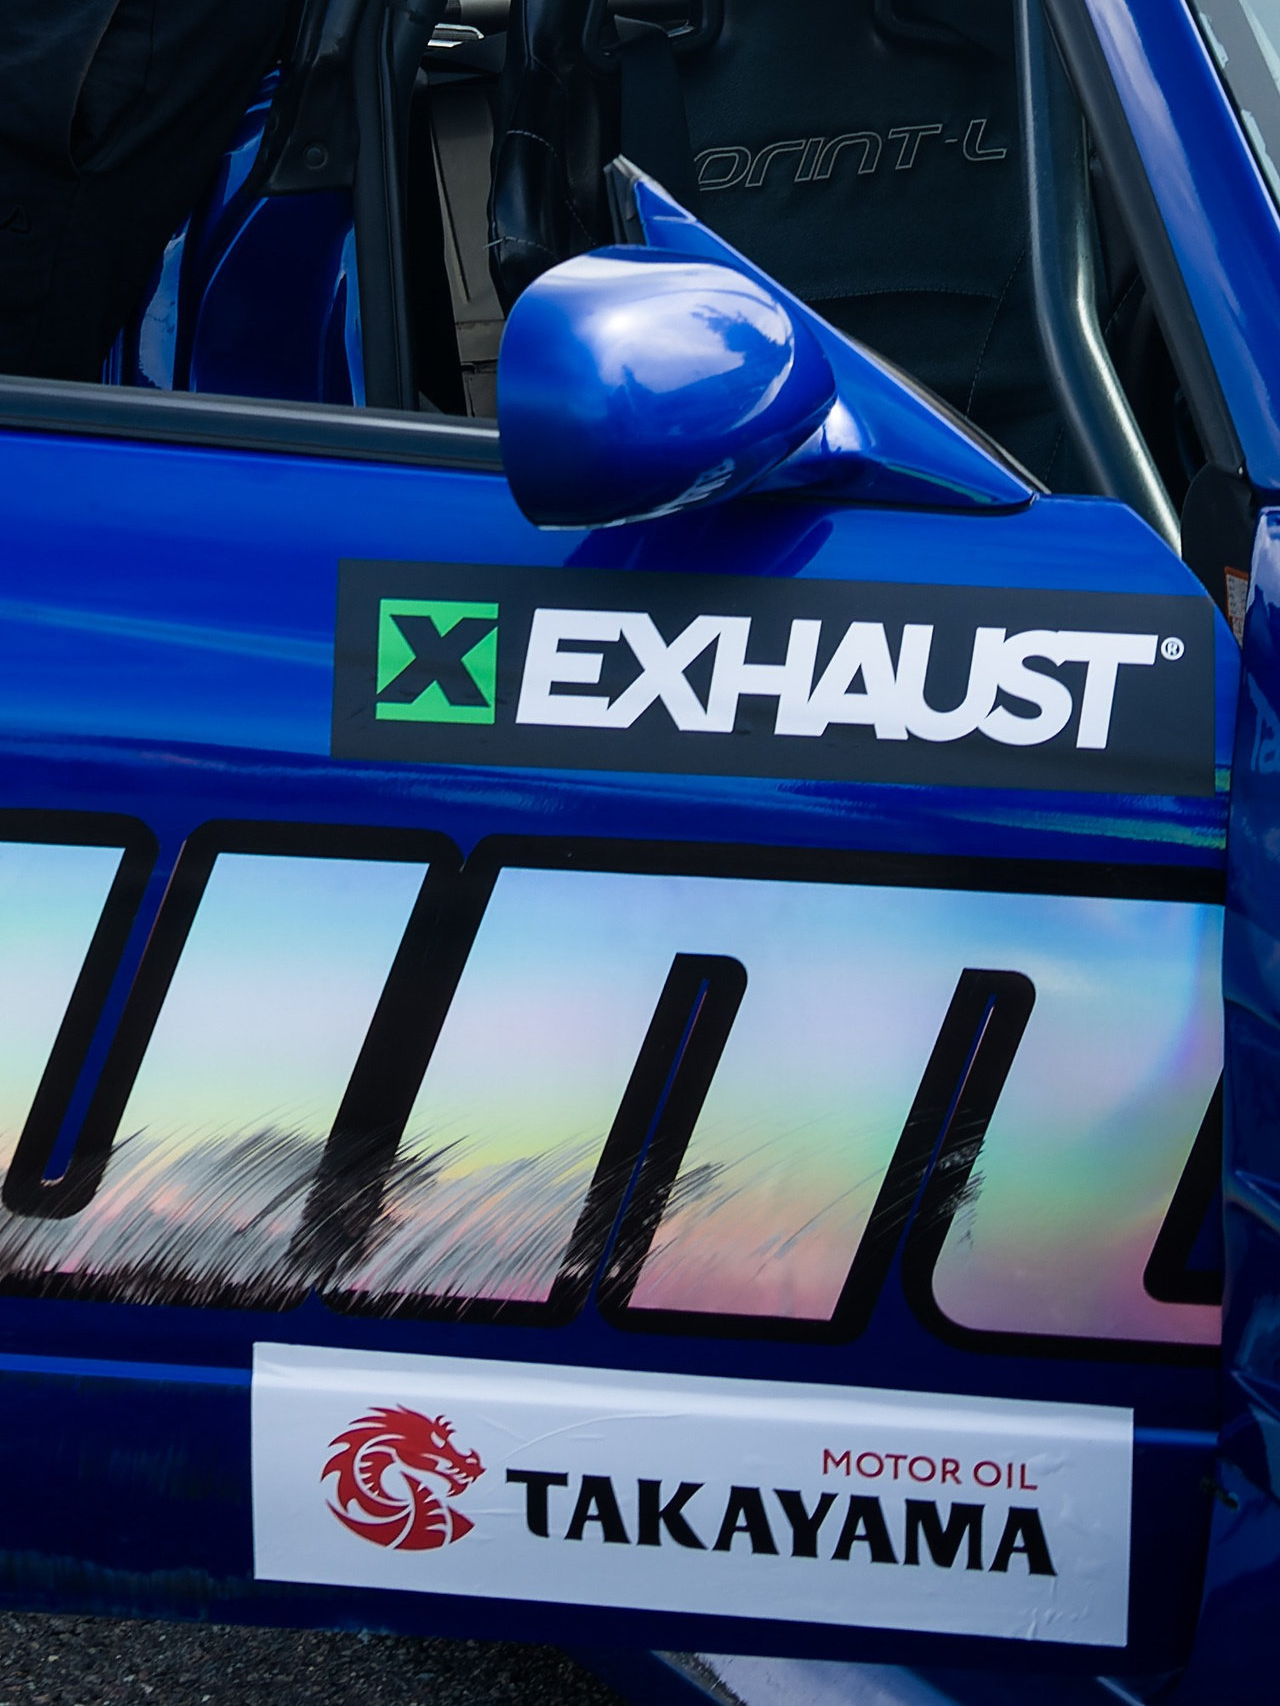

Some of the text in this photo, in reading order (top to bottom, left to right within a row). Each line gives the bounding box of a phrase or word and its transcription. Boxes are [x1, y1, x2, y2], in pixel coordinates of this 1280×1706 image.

[515, 607, 1160, 751] EXHAUST
[505, 1467, 1059, 1578] TAKAYAMA
[821, 1448, 1039, 1491] MOTOR OIL
